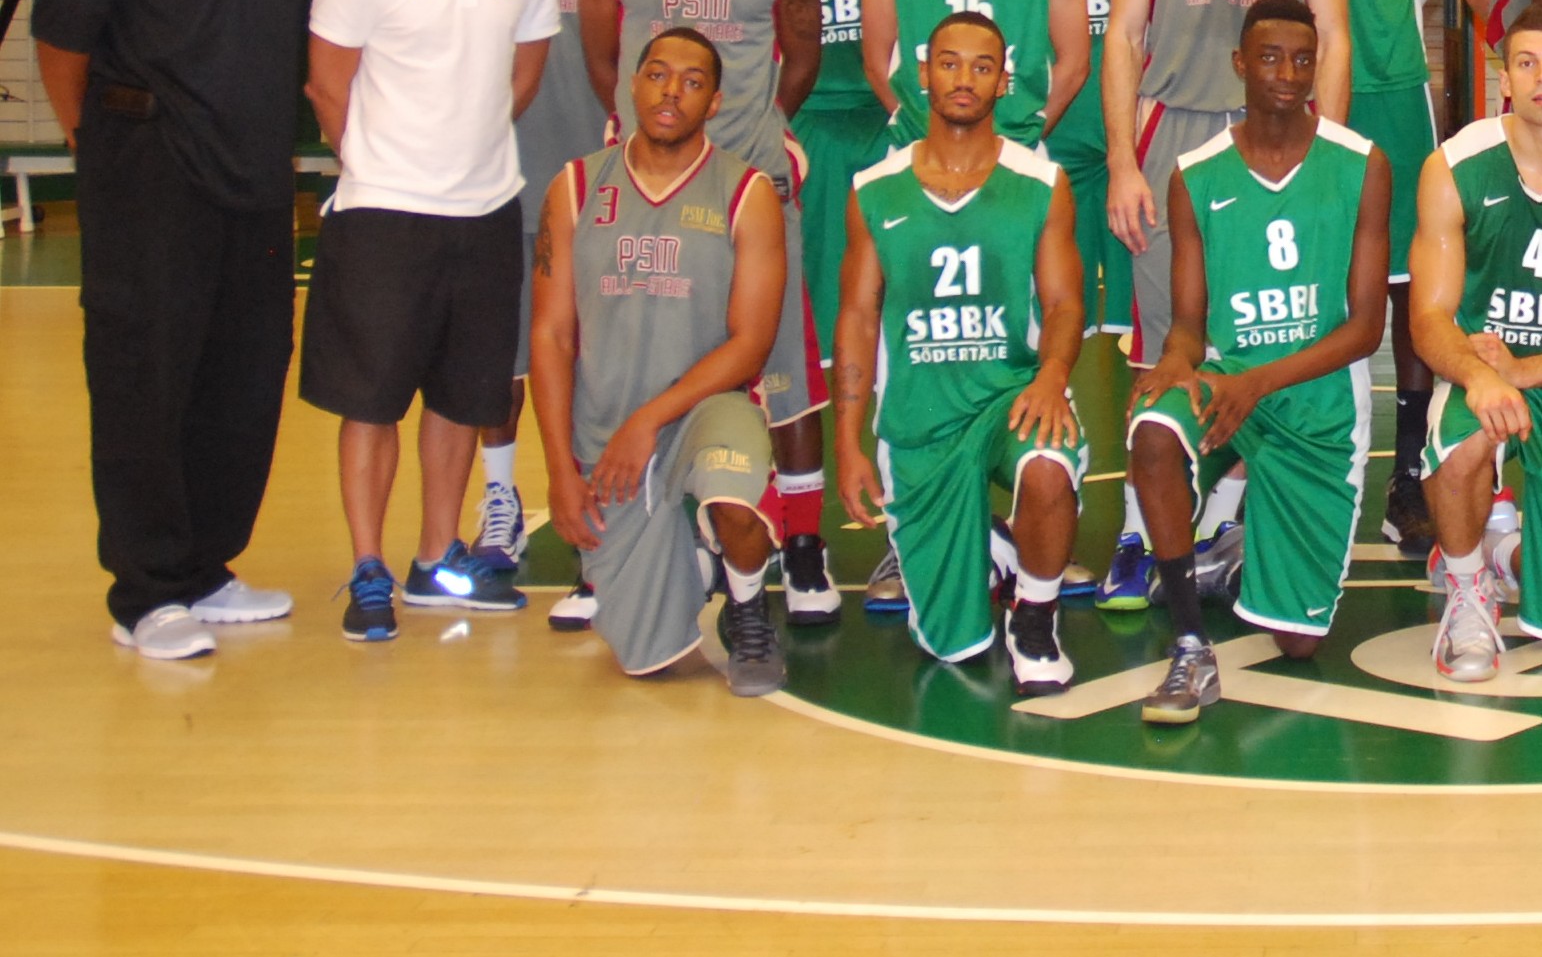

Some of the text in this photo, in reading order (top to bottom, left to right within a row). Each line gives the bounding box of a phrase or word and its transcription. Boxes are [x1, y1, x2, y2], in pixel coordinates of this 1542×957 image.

[594, 184, 620, 226] 3
[617, 235, 681, 274] PSM
[1265, 219, 1300, 271] 8
[930, 245, 982, 298] 21
[906, 305, 1008, 343] SBBK
